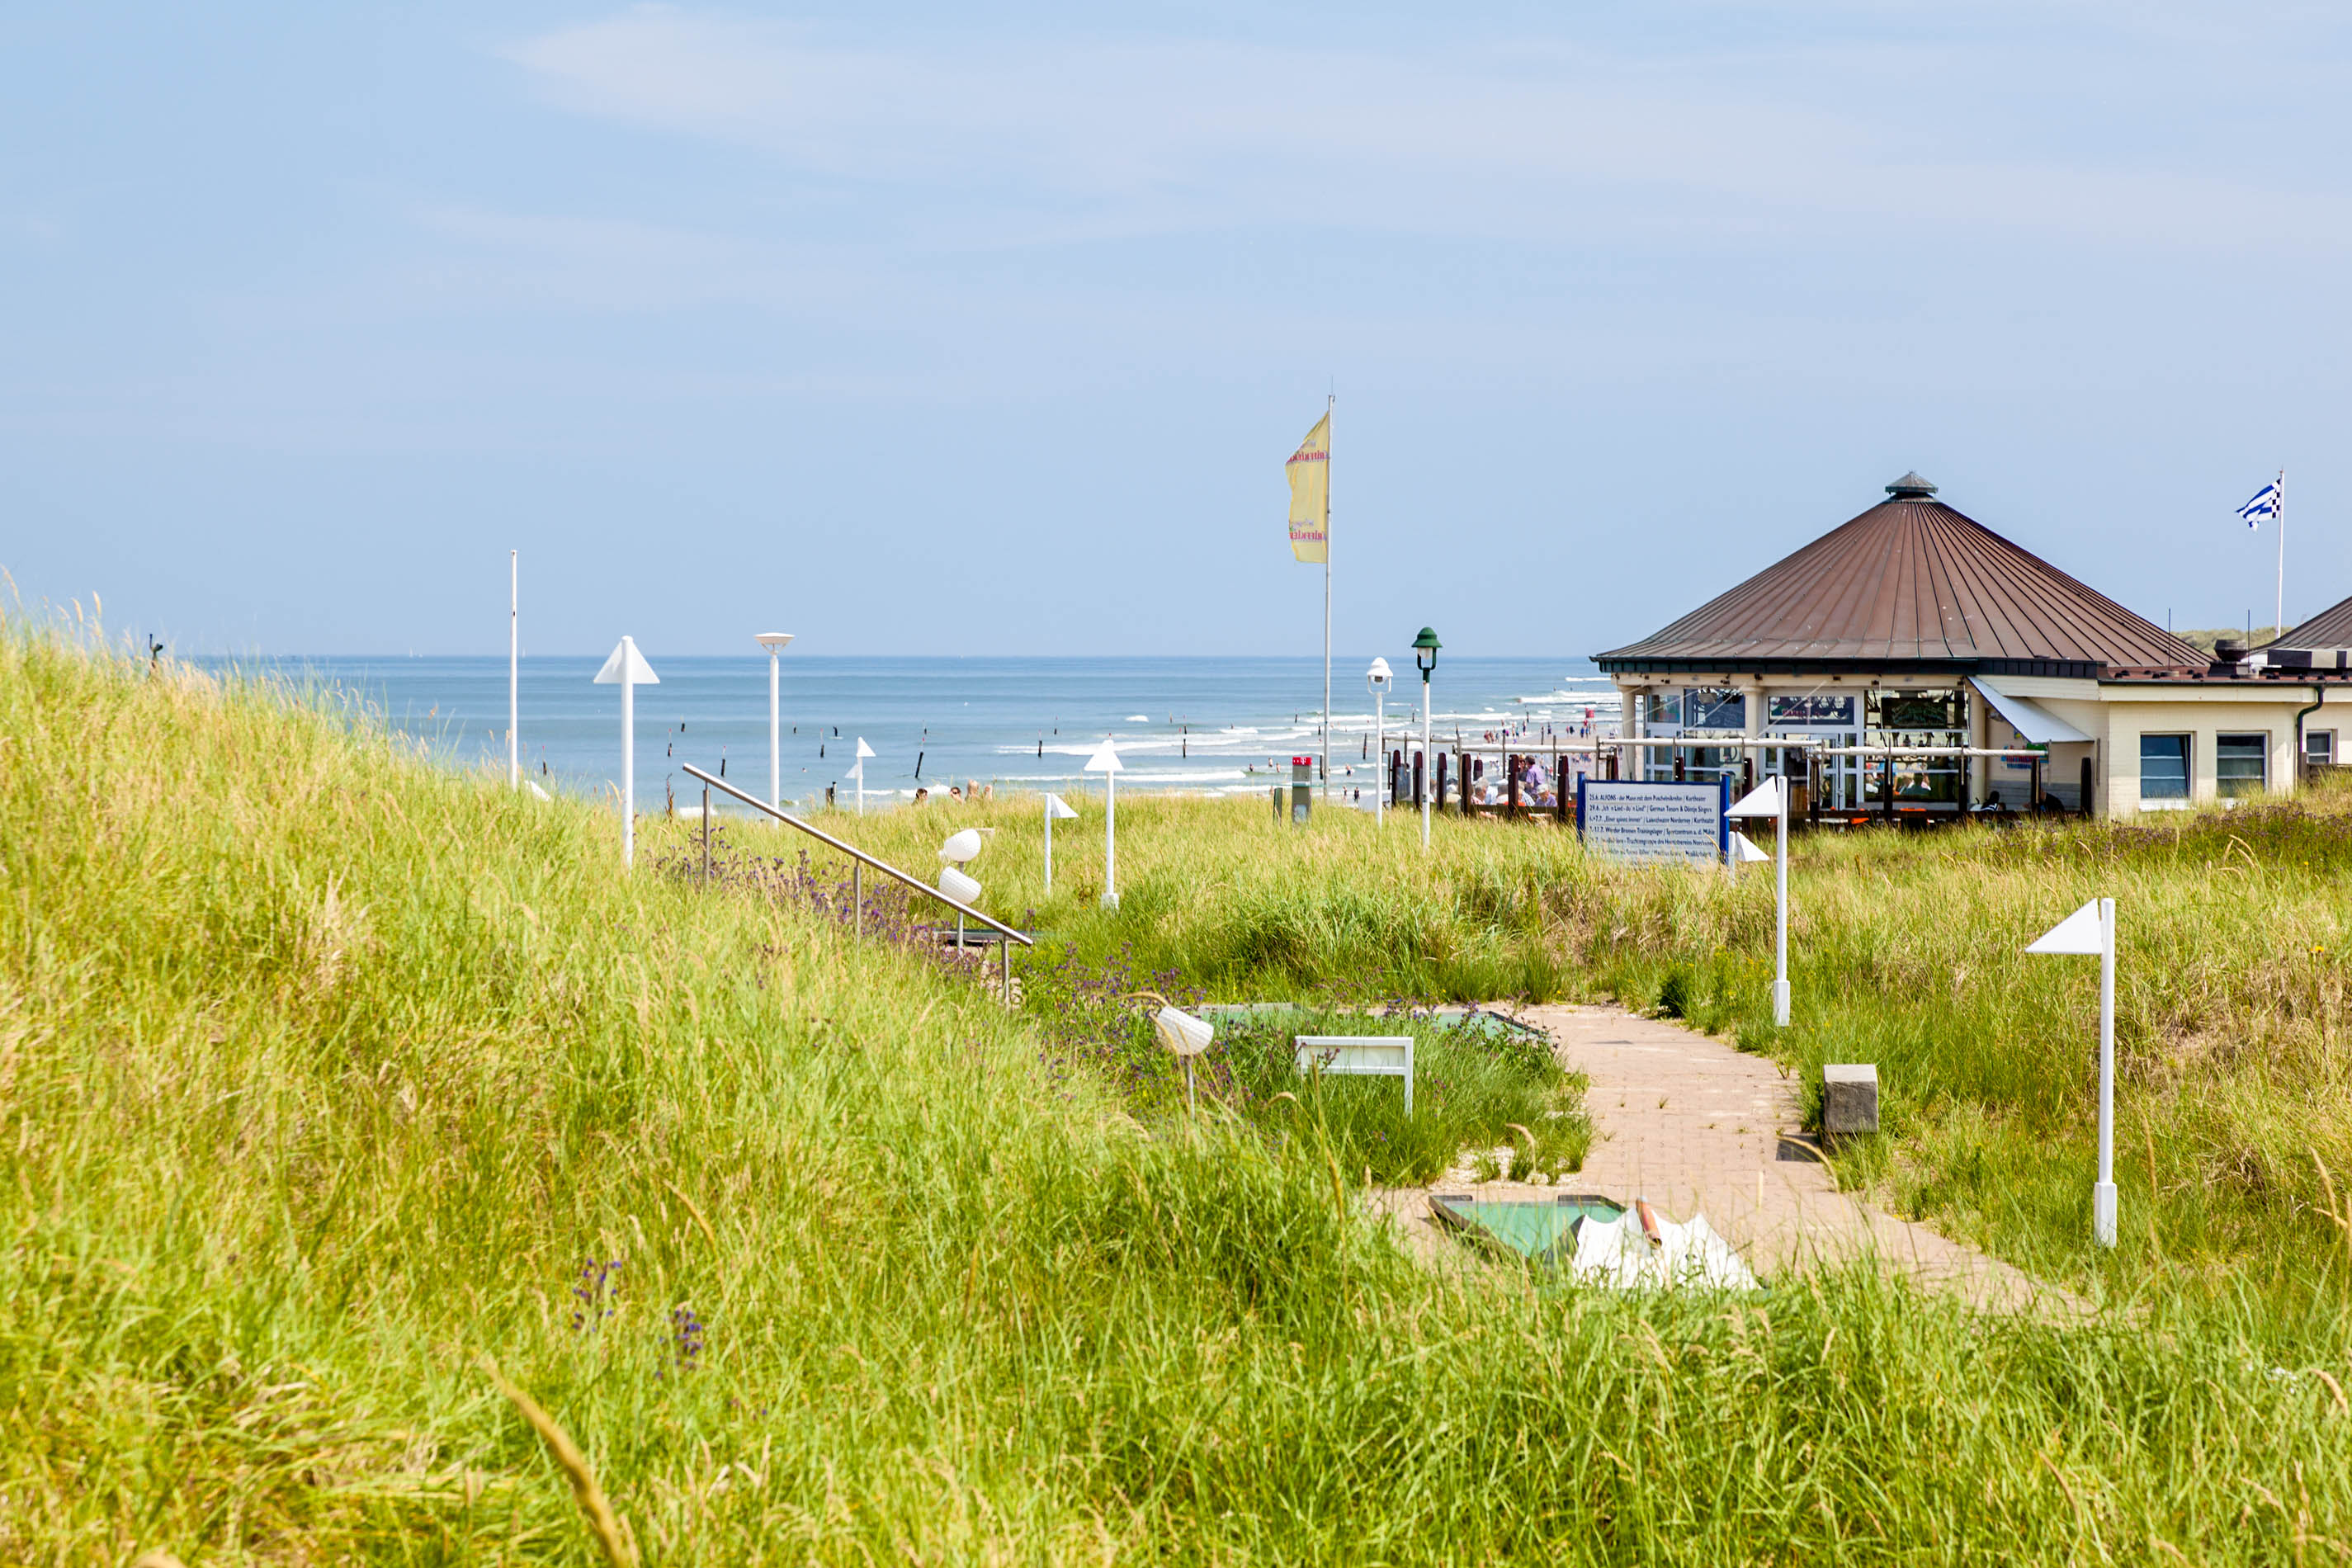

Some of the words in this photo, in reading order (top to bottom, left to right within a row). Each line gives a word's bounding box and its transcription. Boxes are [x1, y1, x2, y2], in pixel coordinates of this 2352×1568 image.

[1698, 805, 1712, 815] Singers
[1616, 815, 1628, 824] spinnt
[1670, 816, 1691, 824] Norderney
[1636, 827, 1663, 836] Trainingslager
